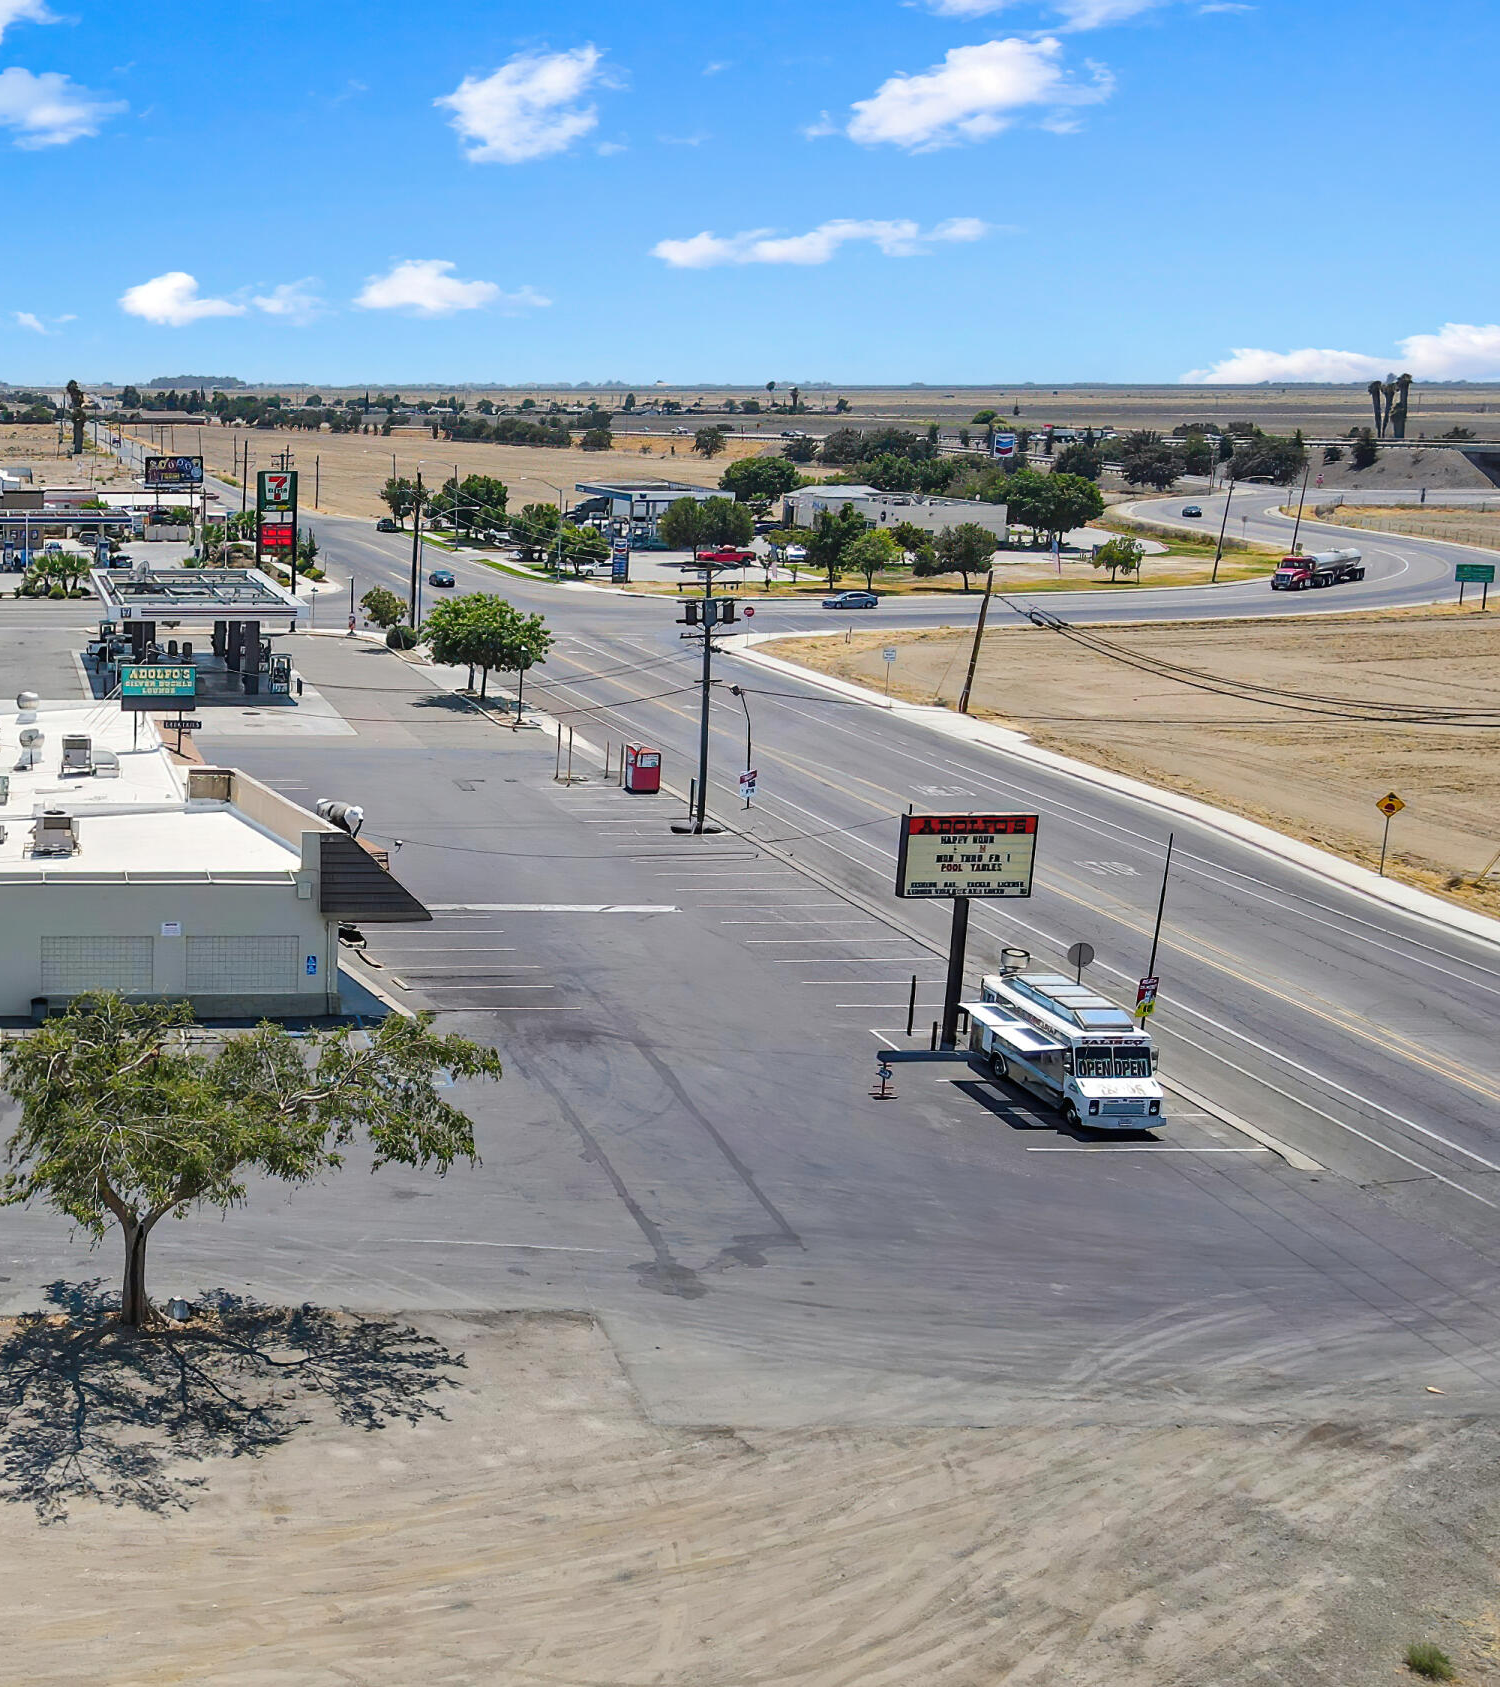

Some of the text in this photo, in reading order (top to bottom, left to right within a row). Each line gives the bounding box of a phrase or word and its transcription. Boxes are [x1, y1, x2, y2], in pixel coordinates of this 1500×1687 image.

[268, 476, 288, 500] 7
[129, 668, 191, 680] ADOLFO'S
[918, 819, 1027, 834] ADOLFO'S
[940, 835, 995, 845] HAPPY HOUR
[935, 854, 954, 863] MON
[940, 863, 1003, 873] POOL TABLES
[1078, 1060, 1147, 1076] OPEN OPEN
